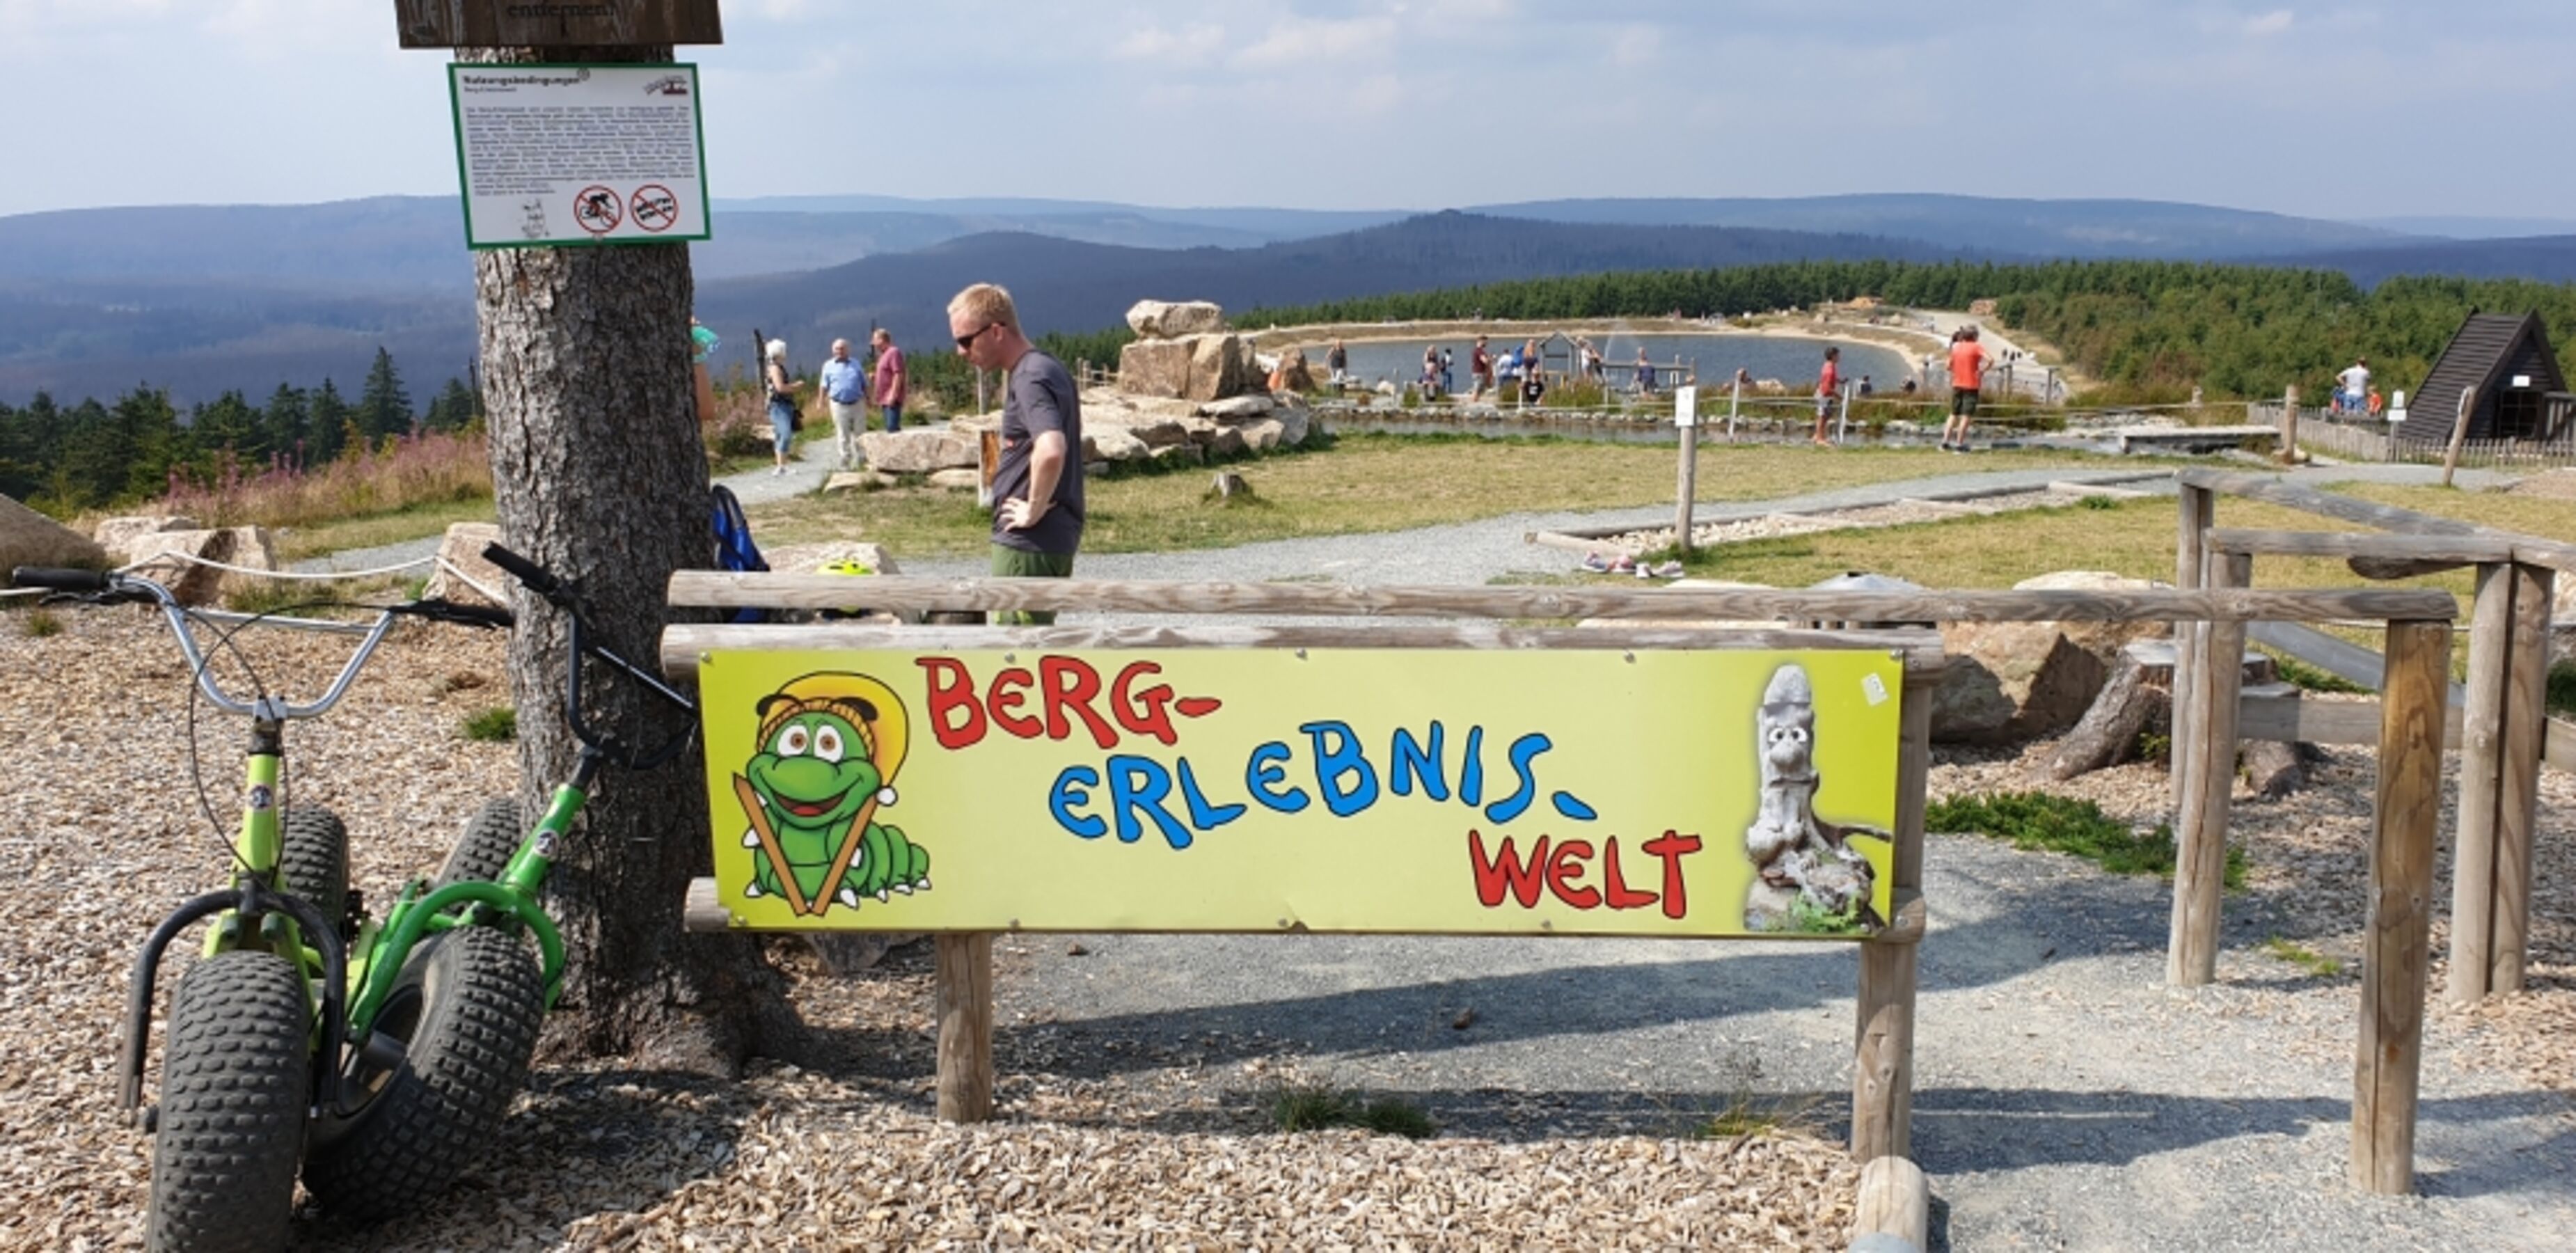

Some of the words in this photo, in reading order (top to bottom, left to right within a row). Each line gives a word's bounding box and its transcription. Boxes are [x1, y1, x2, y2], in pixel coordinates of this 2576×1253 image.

[914, 654, 1222, 750] BERG-
[1049, 720, 1597, 850] ERLEBNIS-
[1469, 828, 1702, 920] WELT
